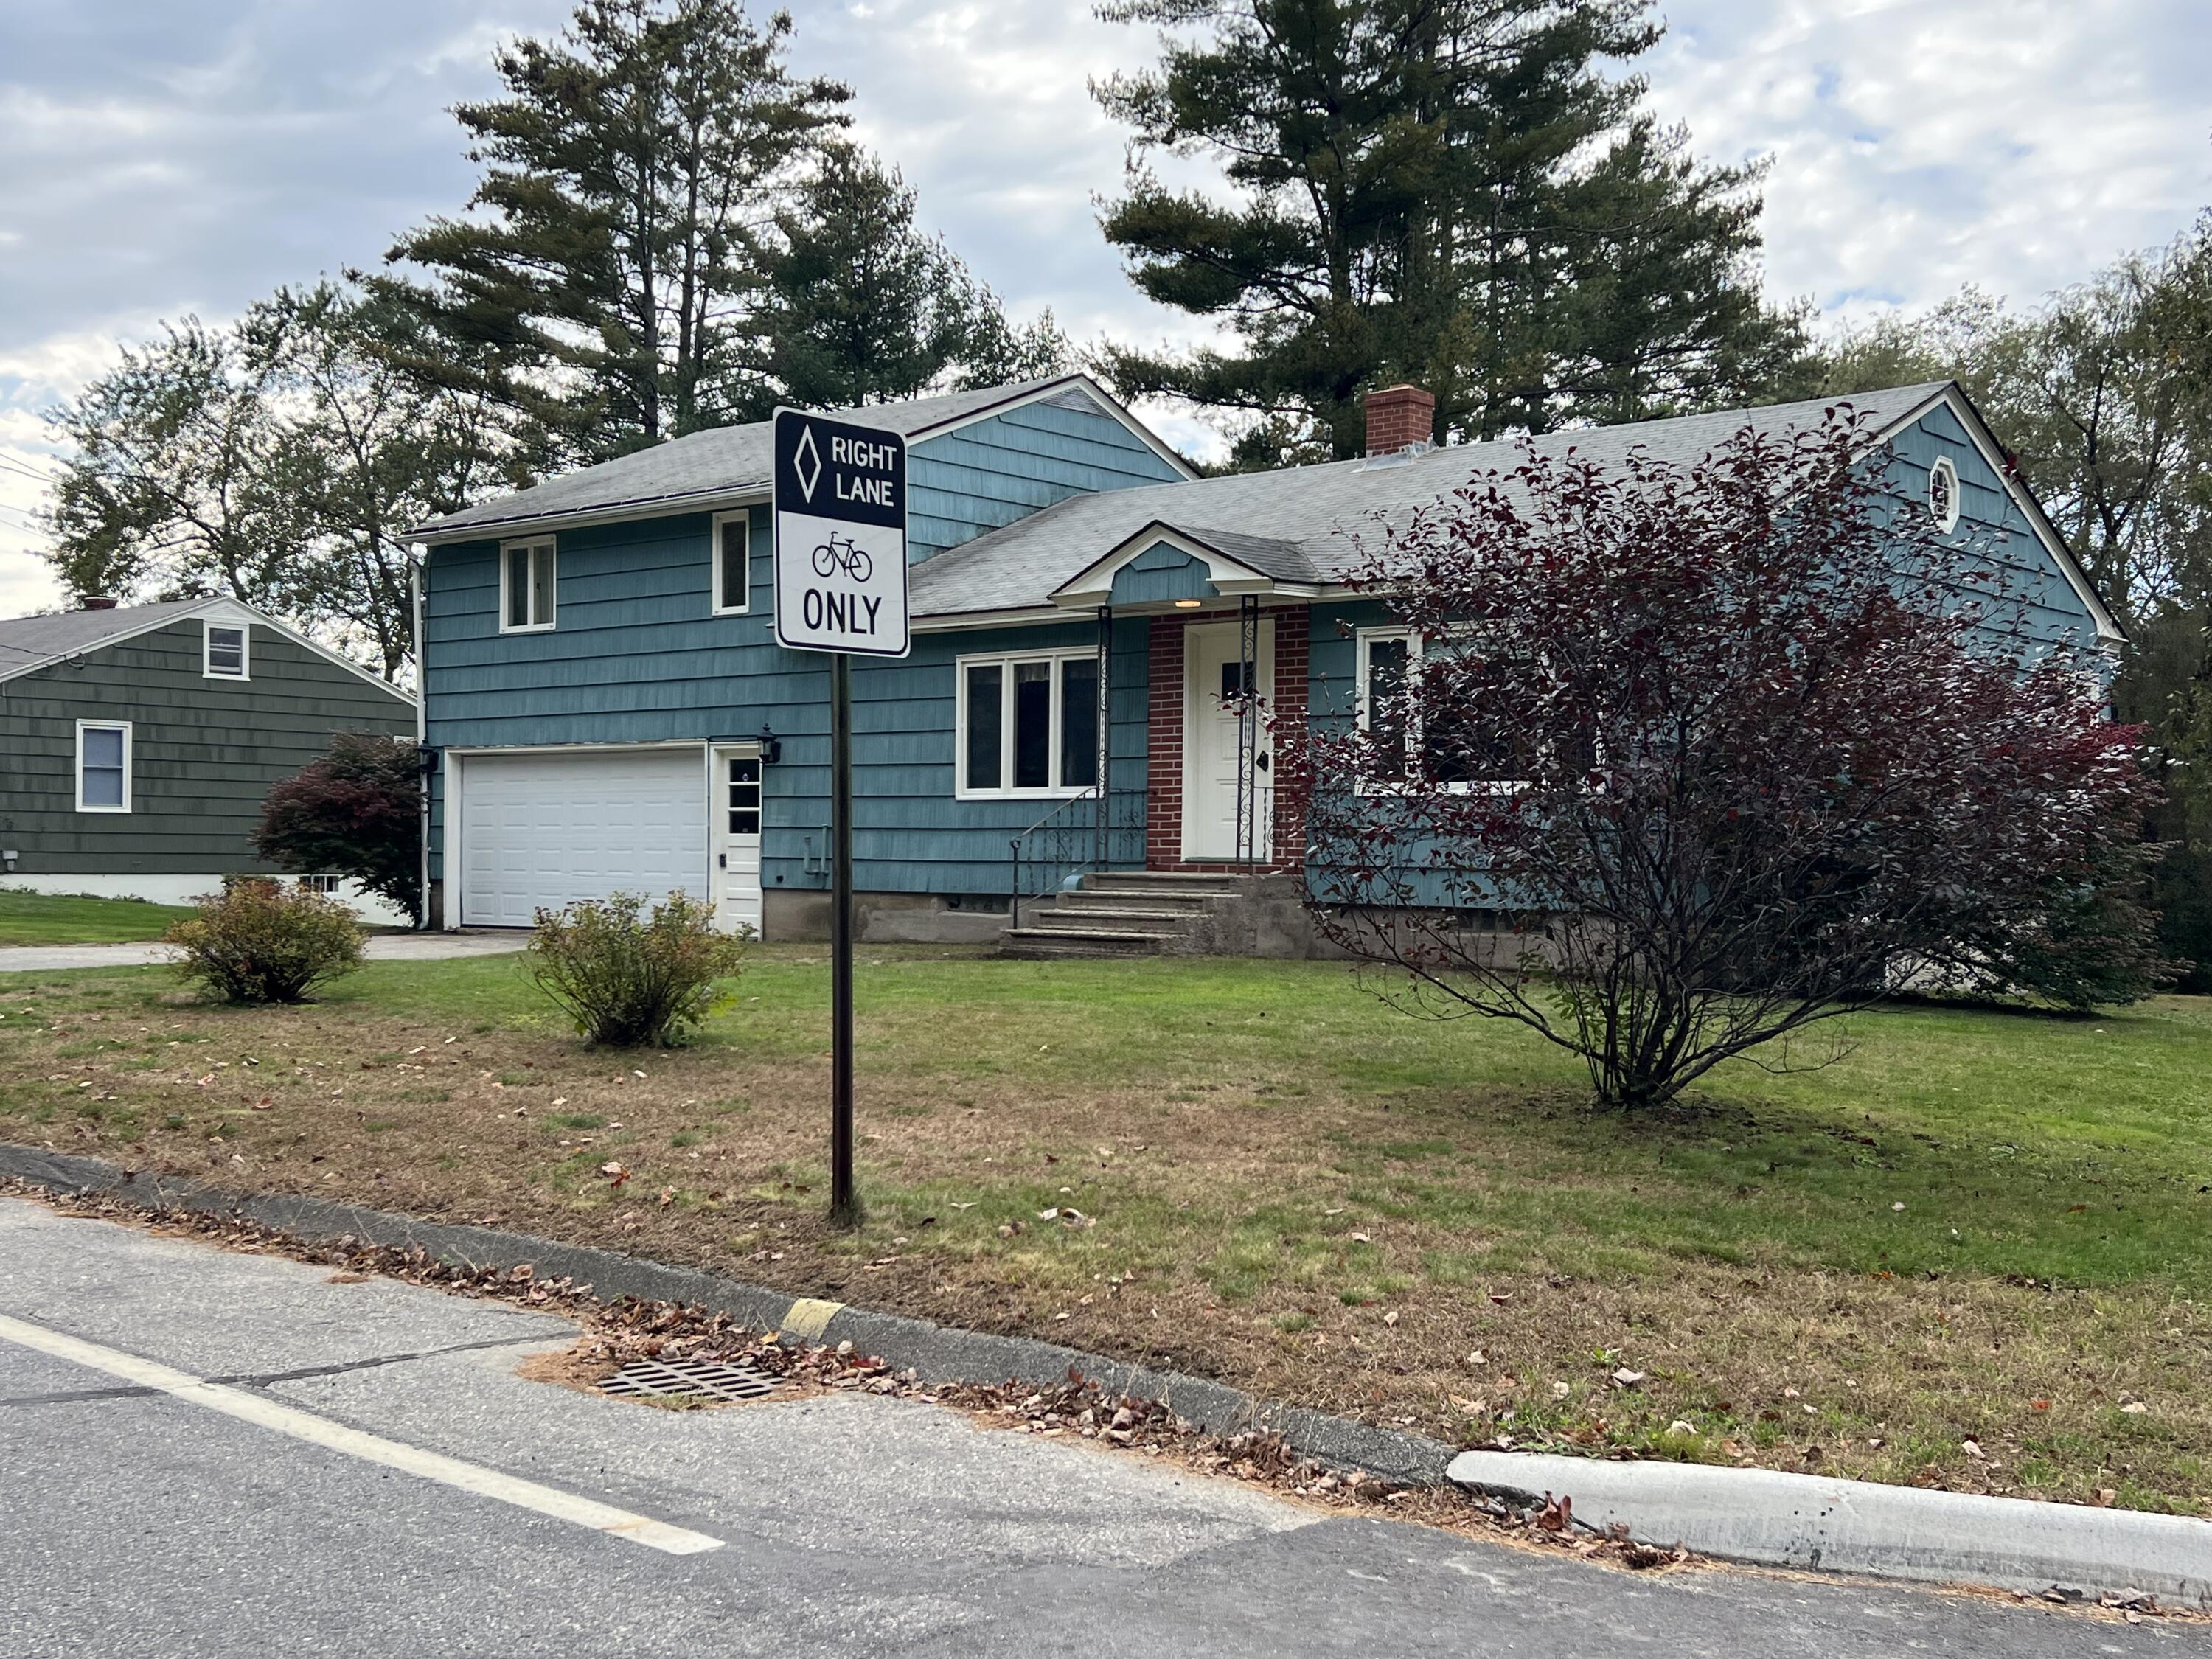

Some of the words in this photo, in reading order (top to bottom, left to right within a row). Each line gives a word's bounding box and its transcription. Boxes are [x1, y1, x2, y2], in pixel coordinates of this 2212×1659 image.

[832, 436, 897, 472] RIGHT
[836, 473, 894, 507] LANE
[804, 588, 882, 635] ONLY
